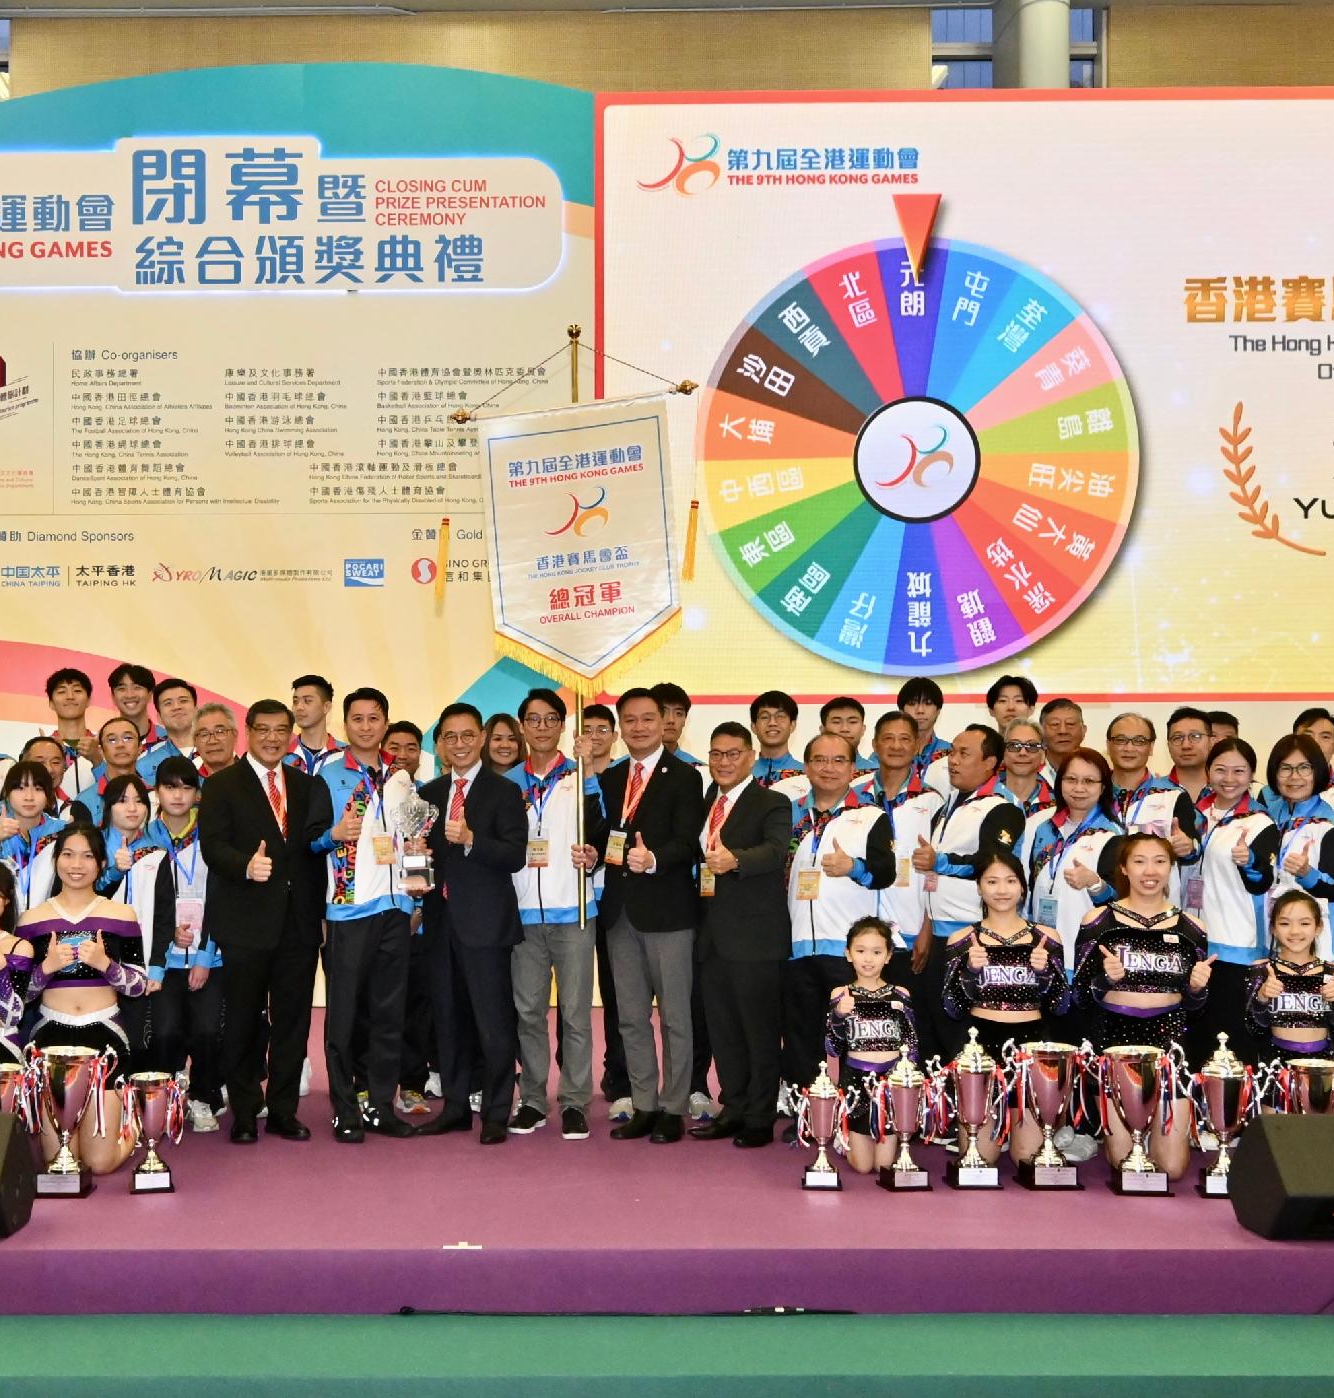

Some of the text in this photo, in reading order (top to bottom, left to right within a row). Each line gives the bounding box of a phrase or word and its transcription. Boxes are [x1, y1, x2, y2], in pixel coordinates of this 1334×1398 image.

[728, 148, 919, 170] 第九屆全港運動會
[132, 147, 366, 225] 閉幕暨
[375, 179, 487, 194] CLOSING CUM
[728, 173, 918, 185] THE 9TH HONG KONG GAMES
[375, 195, 546, 209] PRIZE PRESENTATION
[375, 212, 466, 226] CEREMONY
[30, 240, 112, 258] GAMES
[135, 234, 484, 285] 綜合頒獎典禮
[839, 270, 878, 328] 北區
[899, 260, 925, 317] 元朗
[952, 270, 990, 326] 屯門
[778, 301, 831, 357] 西貢
[998, 297, 1048, 353] 荃灣
[71, 350, 178, 362] 協辦 Co-organisers
[1229, 335, 1266, 352] The
[1272, 335, 1321, 355] Hong
[736, 352, 796, 397] 沙田
[1034, 346, 1092, 391] 葵青
[719, 414, 776, 443] 大埔
[1058, 406, 1115, 441] 離島
[509, 445, 642, 477] 第九屆全港運動會
[509, 463, 644, 488] THE 9TH HONG KONG GAMES
[719, 466, 804, 503] 中西區
[1028, 462, 1115, 499] 油尖旺
[27, 531, 77, 541] Diamond
[81, 531, 134, 542] Sponsors
[456, 529, 483, 539] Gold
[740, 520, 796, 567] 東區
[1011, 502, 1096, 562] 黃大仙
[1, 566, 60, 578] 中国太平
[75, 565, 135, 577] 太平香港
[446, 559, 490, 568] INO GR
[537, 545, 629, 570] 香港賽馬會盃
[780, 560, 831, 617] 南區
[986, 536, 1058, 614] 深水埗
[549, 581, 622, 610] 總冠軍
[539, 605, 635, 625] OVERALL CHAMPION
[838, 592, 876, 649] 灣仔
[906, 571, 933, 657] 九龍城
[957, 588, 998, 647] 觀塘
[1117, 944, 1183, 974] JENGA
[978, 965, 1039, 988] JENGA
